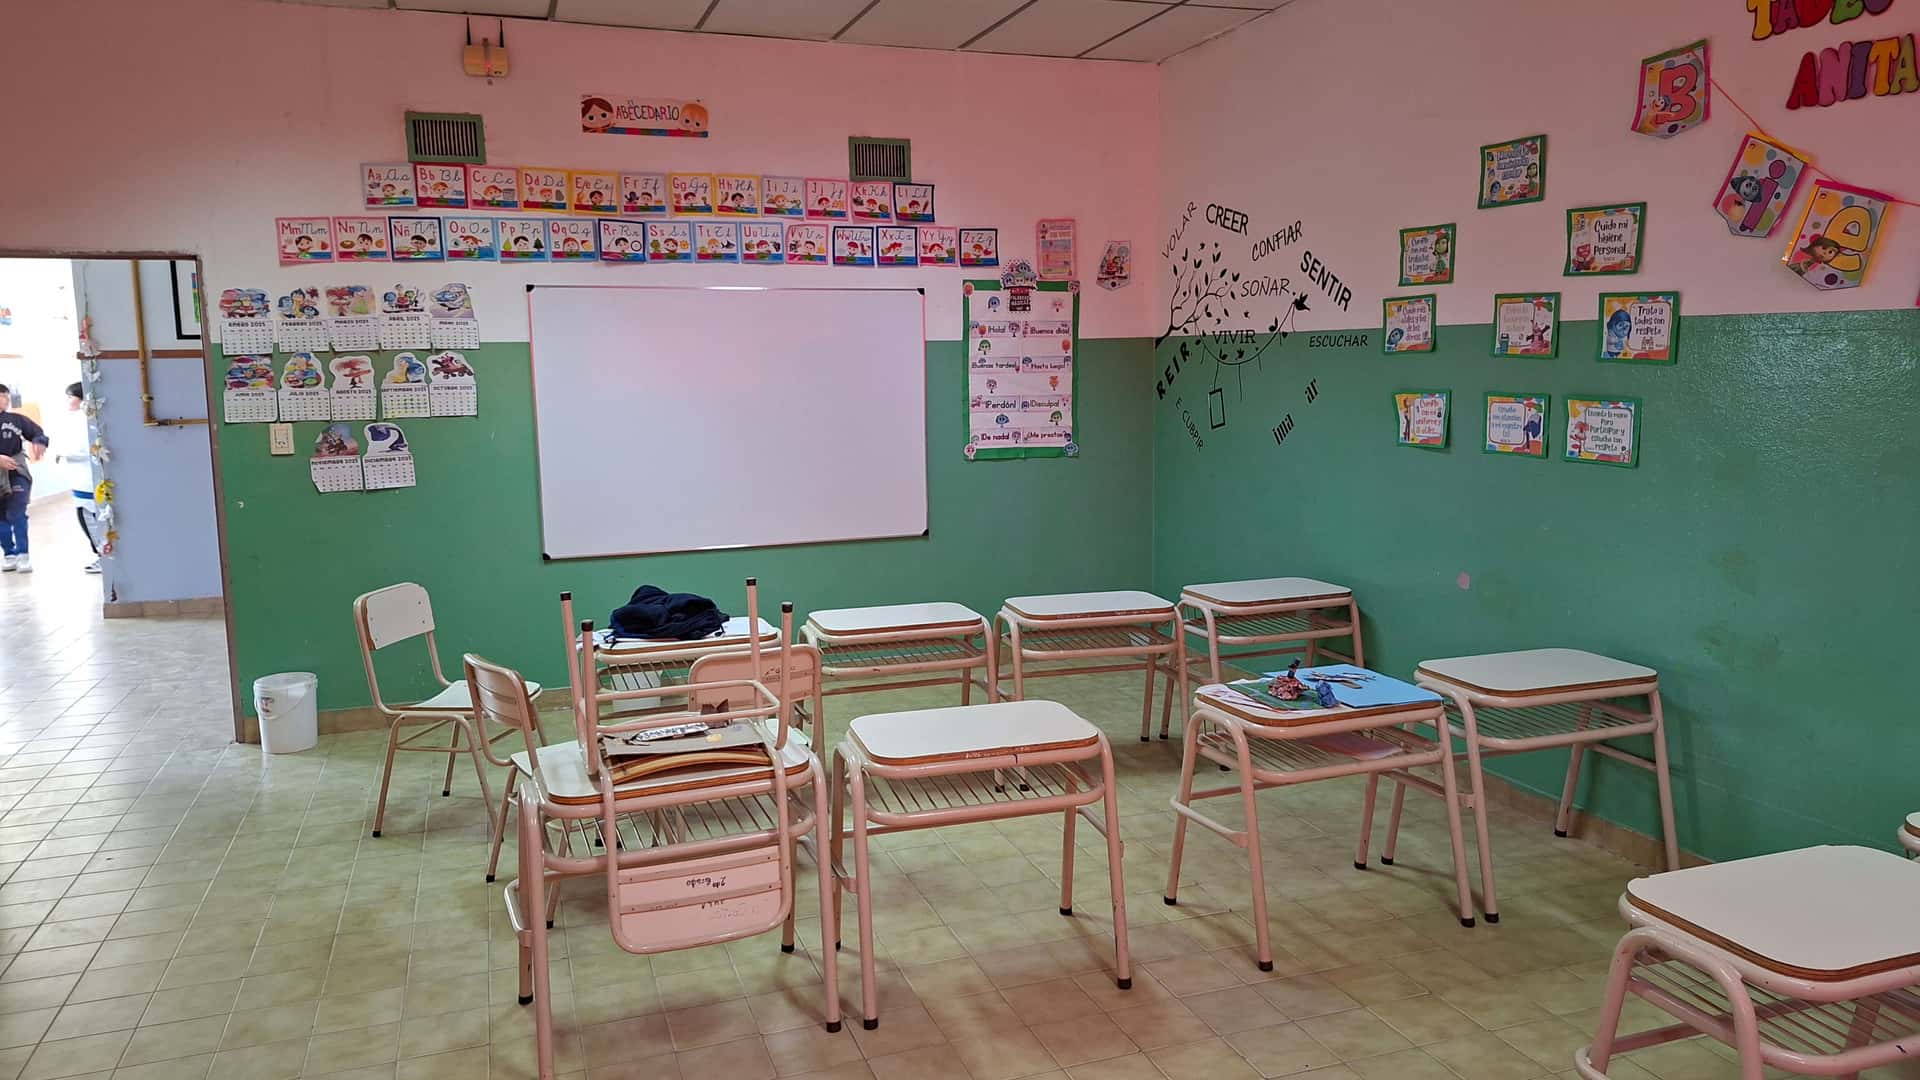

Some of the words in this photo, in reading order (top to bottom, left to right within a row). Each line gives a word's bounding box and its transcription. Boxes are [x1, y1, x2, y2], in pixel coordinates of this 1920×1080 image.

[1786, 33, 1920, 110] ANITA
[615, 105, 680, 121] ABECEDARIO
[1162, 201, 1197, 258] VOLAR
[1206, 203, 1249, 236] CREER
[1619, 219, 1629, 229] mi
[1252, 220, 1302, 261] CONFIAR
[1241, 276, 1290, 297] SOÑAR
[1300, 250, 1352, 312] SENTIR
[1212, 330, 1256, 344] VIVIR
[1309, 335, 1368, 347] ESCUCHAR
[1156, 341, 1191, 400] REIR
